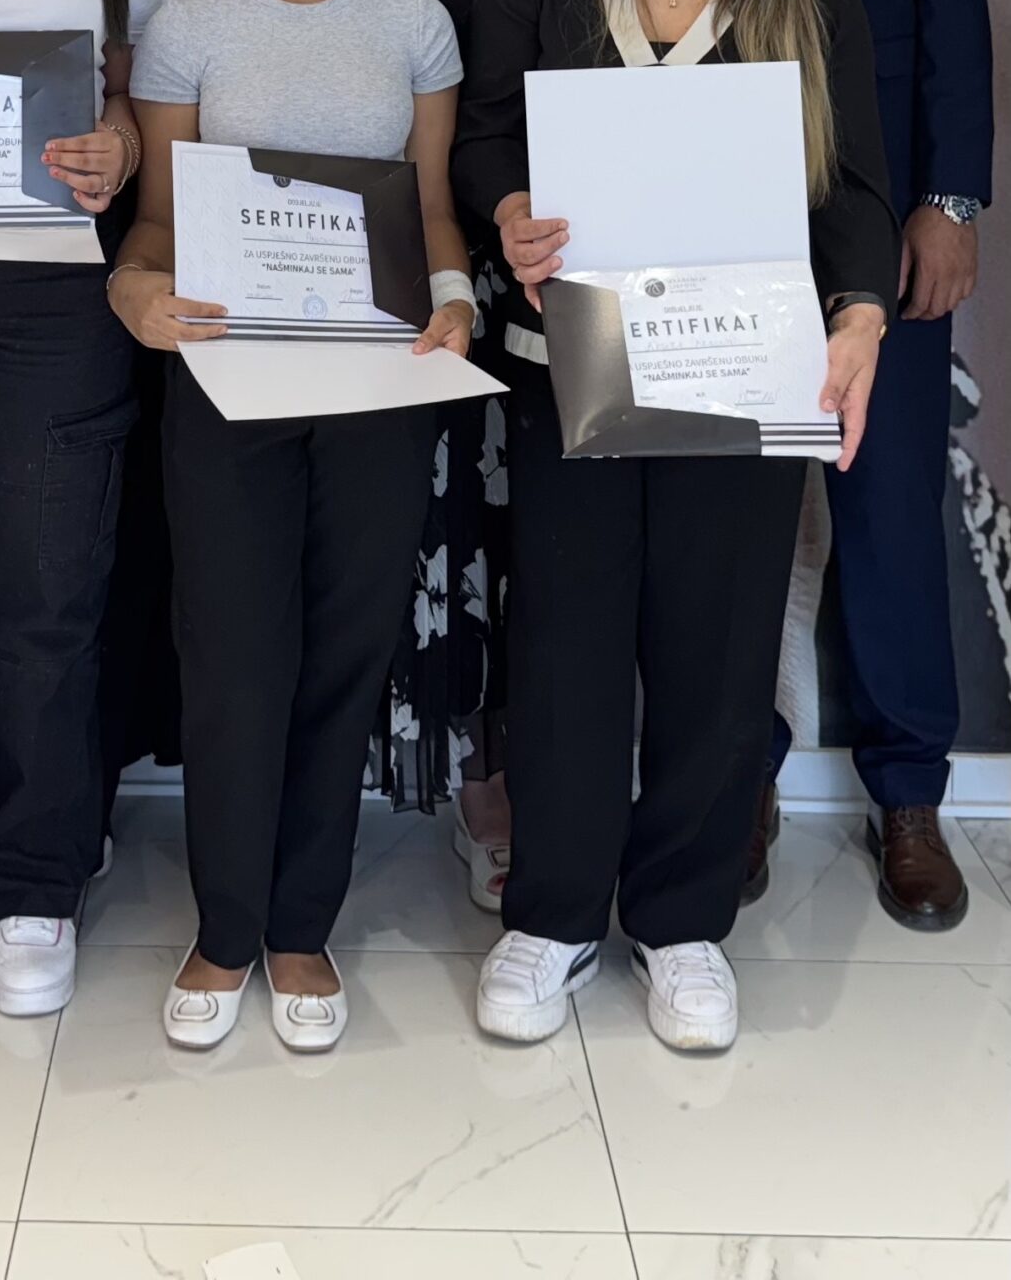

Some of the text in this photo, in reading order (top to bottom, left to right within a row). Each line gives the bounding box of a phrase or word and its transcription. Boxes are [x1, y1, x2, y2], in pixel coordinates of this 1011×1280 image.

[241, 208, 366, 232] SERTIFIKAT
[244, 250, 255, 258] ZA
[256, 250, 298, 261] USPJEŠNO
[300, 253, 341, 264] ZAVRŠENU
[317, 266, 328, 275] SE
[630, 314, 758, 338] ERTIFIKAT
[635, 359, 683, 371] USPJEŠNO
[685, 356, 733, 368] ZAVRŠENU
[735, 354, 768, 364] OBUKU
[706, 370, 718, 378] SE
